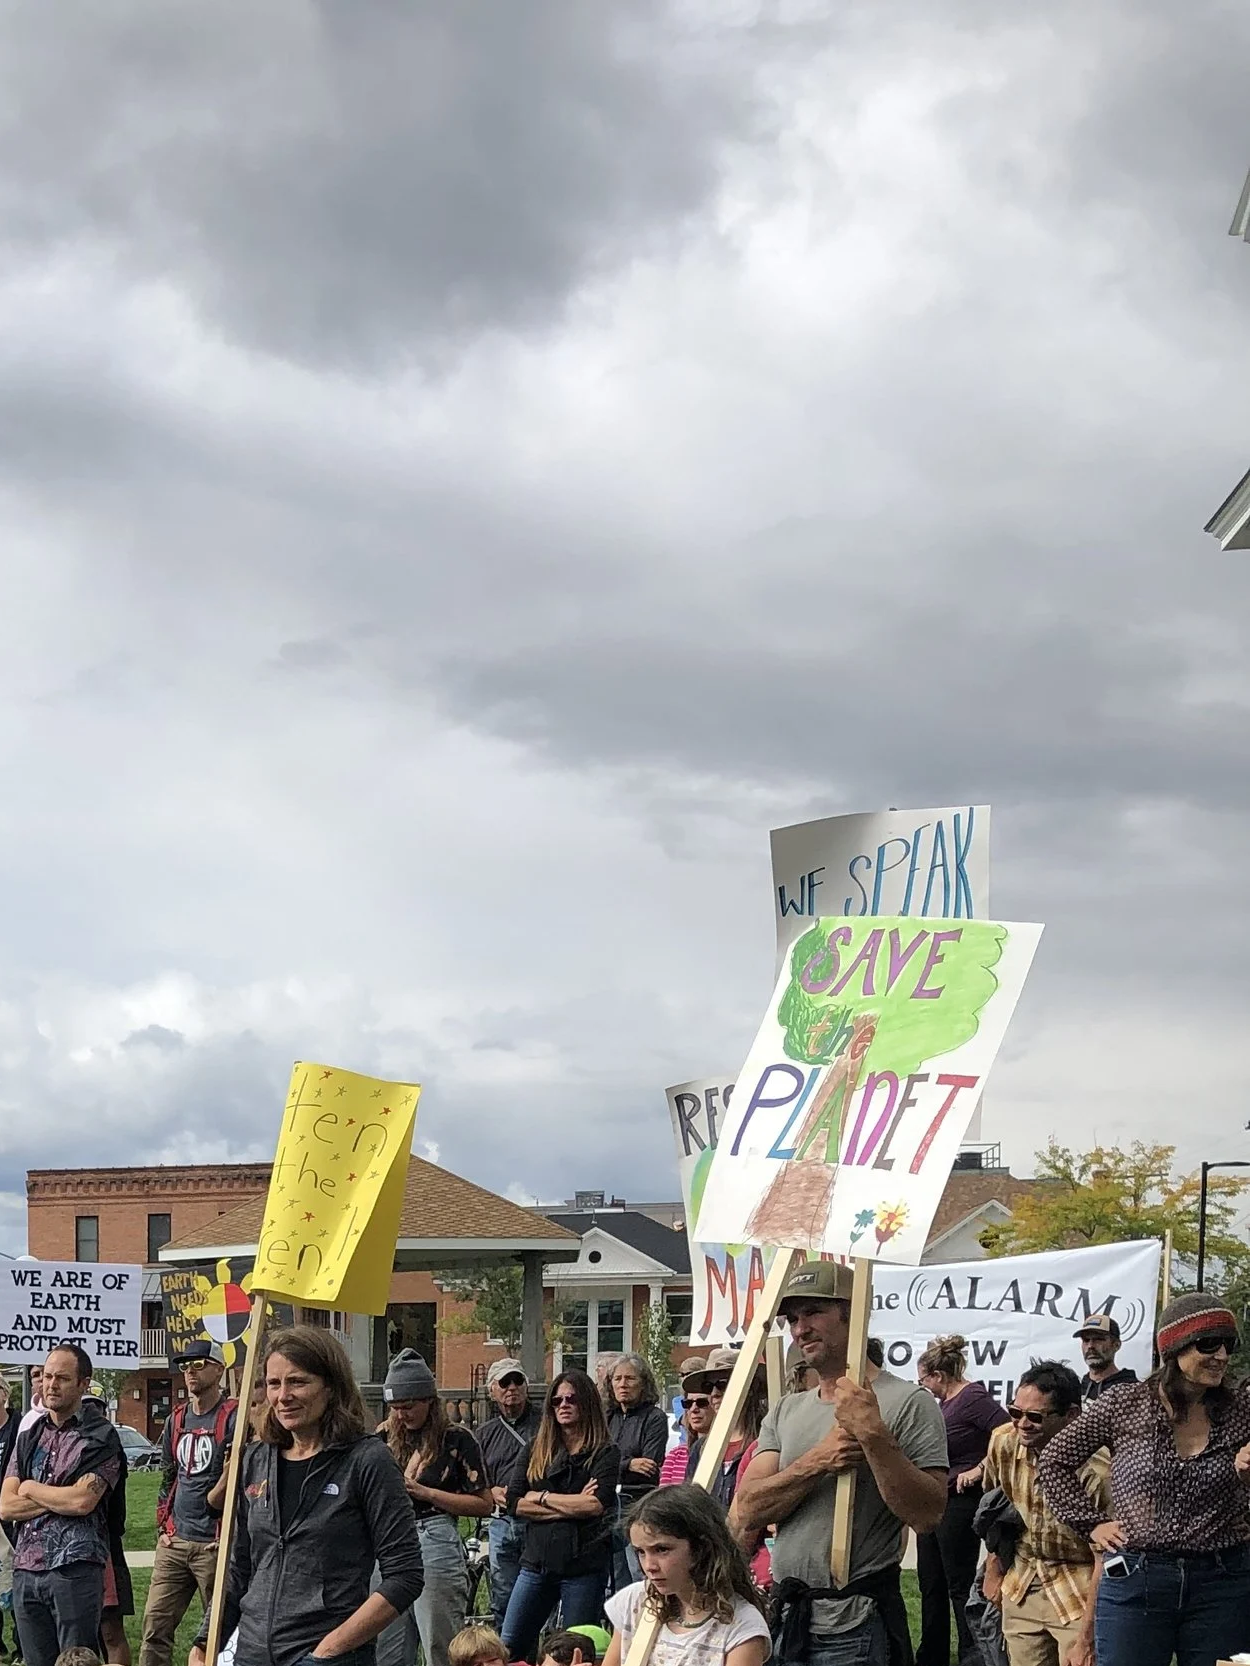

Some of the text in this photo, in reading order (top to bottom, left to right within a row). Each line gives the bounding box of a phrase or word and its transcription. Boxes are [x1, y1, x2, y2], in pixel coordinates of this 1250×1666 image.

[800, 926, 963, 999] SAVE
[807, 1004, 875, 1060] the
[730, 1063, 980, 1176] PLANET
[274, 1146, 337, 1198] the
[11, 1270, 129, 1290] WE ARE OF
[162, 1271, 199, 1292] EARTH
[30, 1292, 101, 1311] EARTH
[170, 1289, 209, 1311] NEEDS
[928, 1275, 1121, 1323] ALARM
[12, 1314, 126, 1335] AND MUST
[165, 1314, 198, 1333] HELP
[96, 1340, 138, 1357] HER
